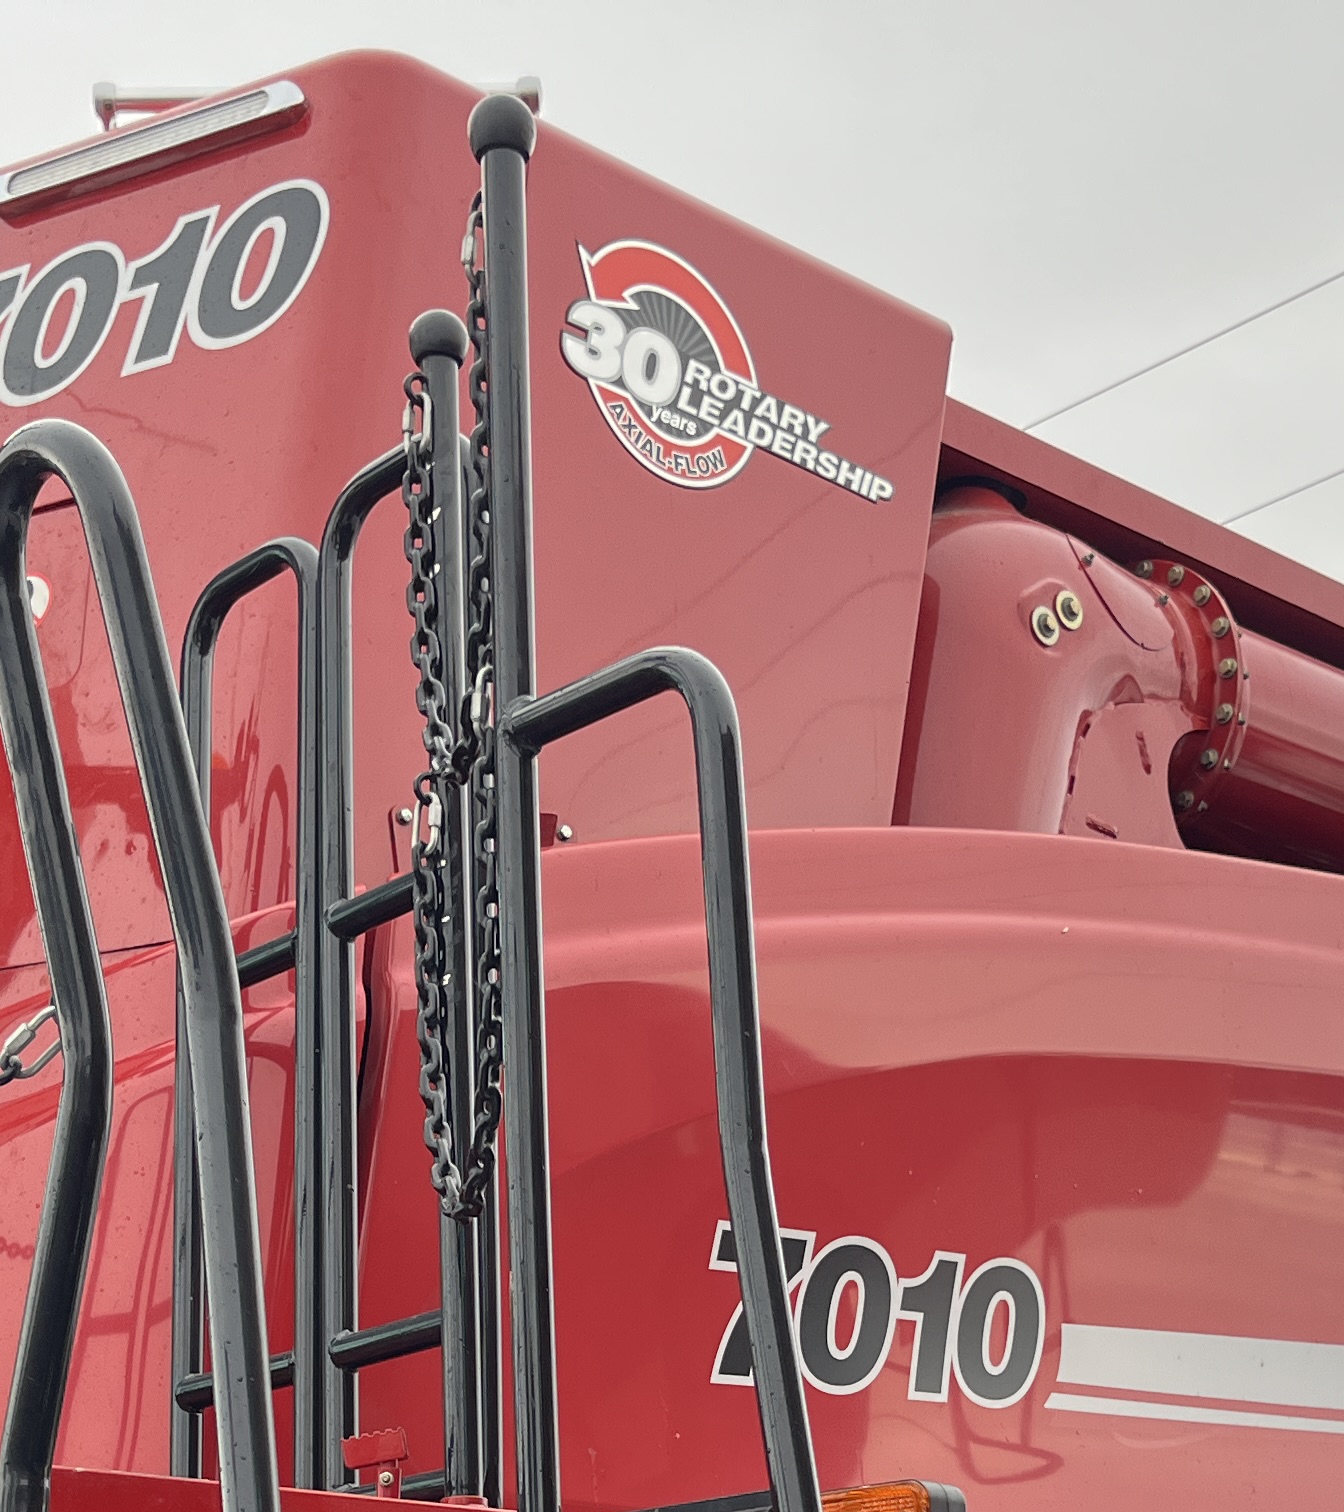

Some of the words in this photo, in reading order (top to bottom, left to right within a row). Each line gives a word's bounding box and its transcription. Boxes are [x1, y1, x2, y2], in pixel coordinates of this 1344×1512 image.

[560, 299, 682, 407] 30
[608, 402, 725, 477] AXIAL-FLOW
[650, 406, 697, 437] years
[684, 358, 831, 443] ROTARY
[677, 385, 894, 502] LEADERSHIP
